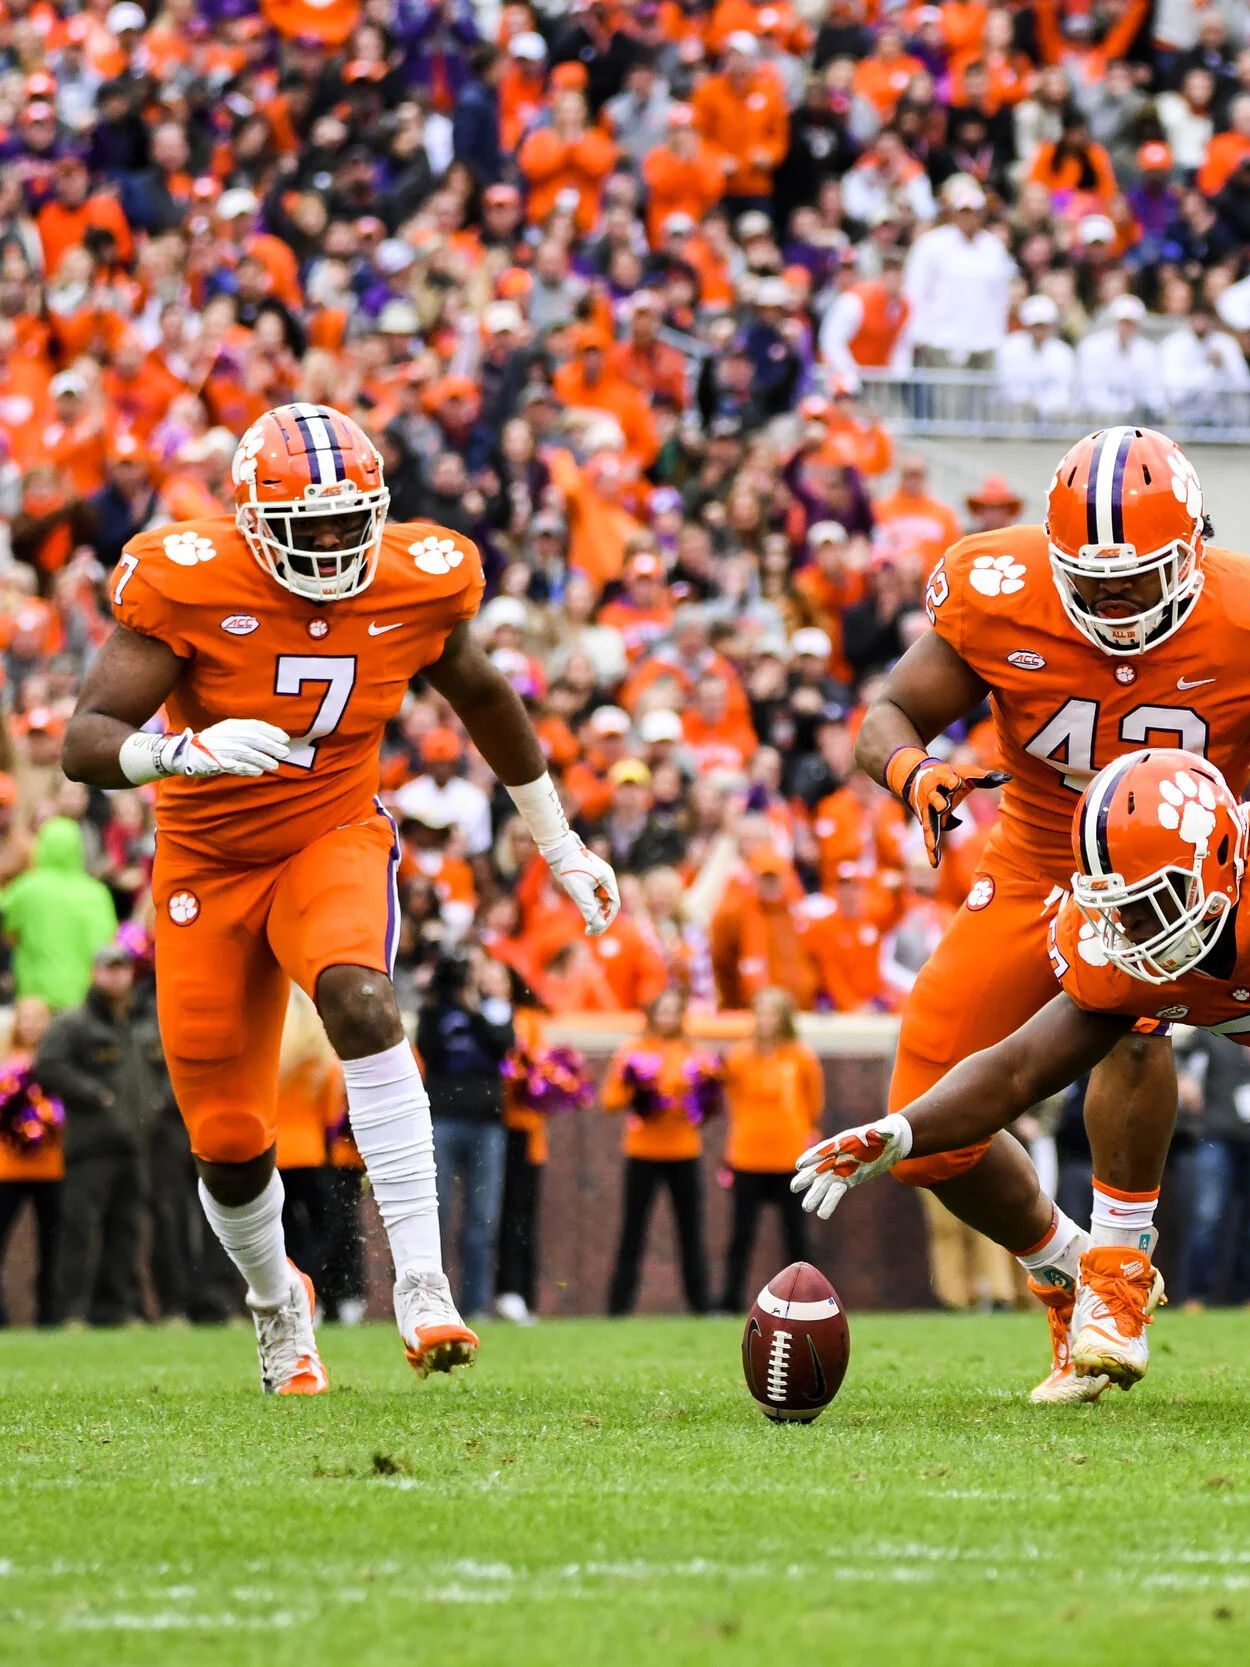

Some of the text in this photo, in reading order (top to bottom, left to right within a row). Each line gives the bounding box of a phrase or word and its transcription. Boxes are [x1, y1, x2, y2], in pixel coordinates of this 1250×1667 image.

[114, 552, 140, 606] 7
[226, 618, 254, 628] ACC
[1013, 654, 1041, 665] ACC
[274, 654, 358, 770] 7
